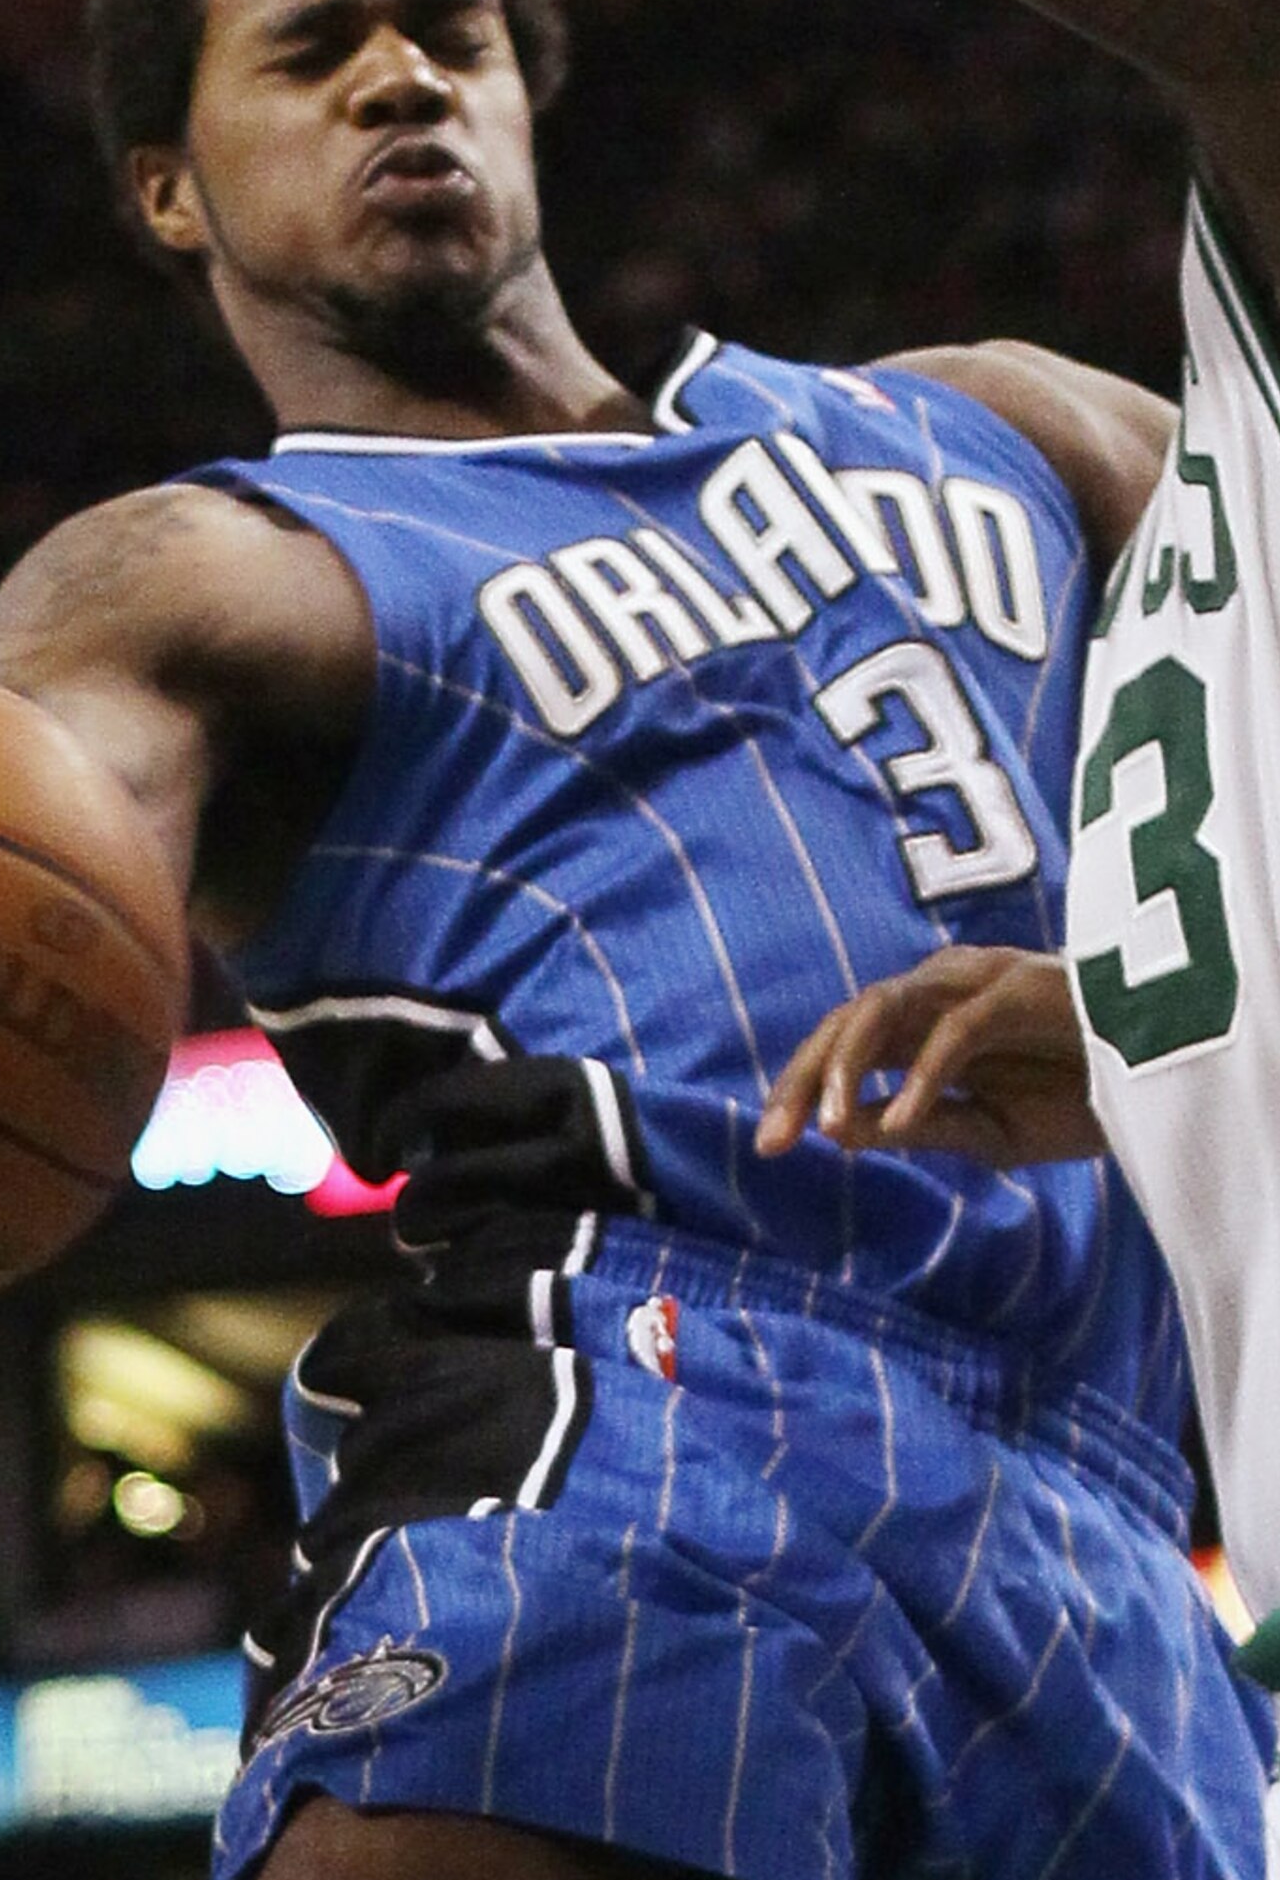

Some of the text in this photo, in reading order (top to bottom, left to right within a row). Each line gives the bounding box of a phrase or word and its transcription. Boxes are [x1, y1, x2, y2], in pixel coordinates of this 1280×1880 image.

[477, 430, 1049, 739] ORLANDO
[814, 640, 1038, 905] 3
[1073, 654, 1240, 1068] 3
